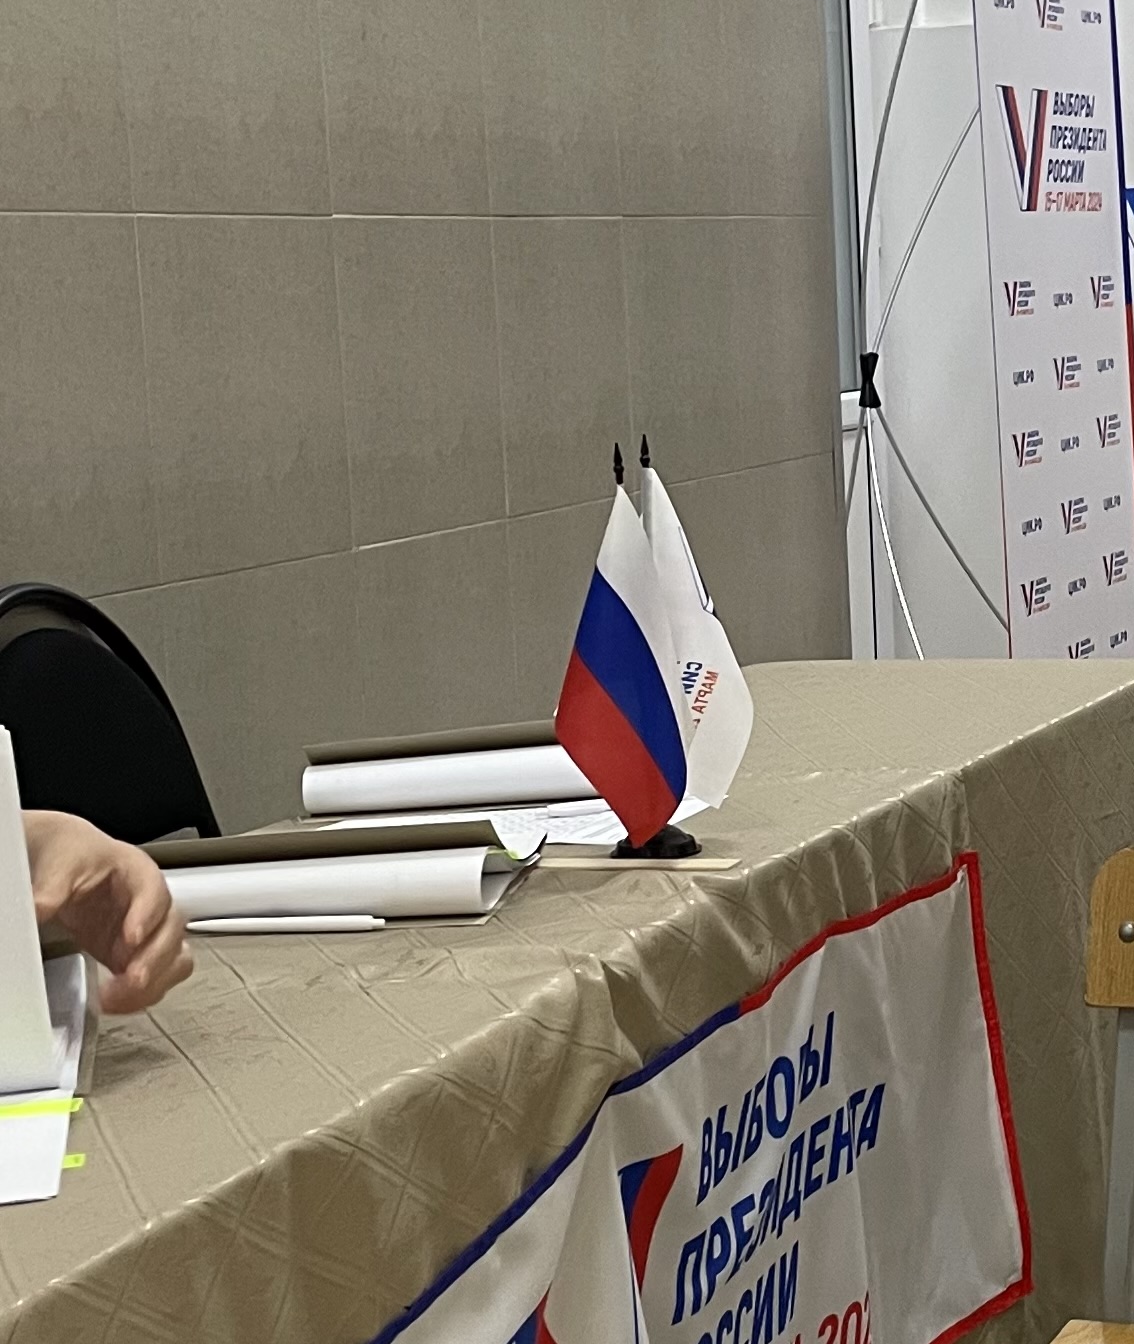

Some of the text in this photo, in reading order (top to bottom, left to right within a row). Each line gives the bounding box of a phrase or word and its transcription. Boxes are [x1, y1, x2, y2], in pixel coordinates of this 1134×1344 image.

[1053, 91, 1095, 118] ВЫБОРЫ
[1049, 125, 1107, 154] ПРЕЗИДЕНТА
[1047, 158, 1085, 183] РОССИИ
[696, 1011, 834, 1207] ВЫБОЫ
